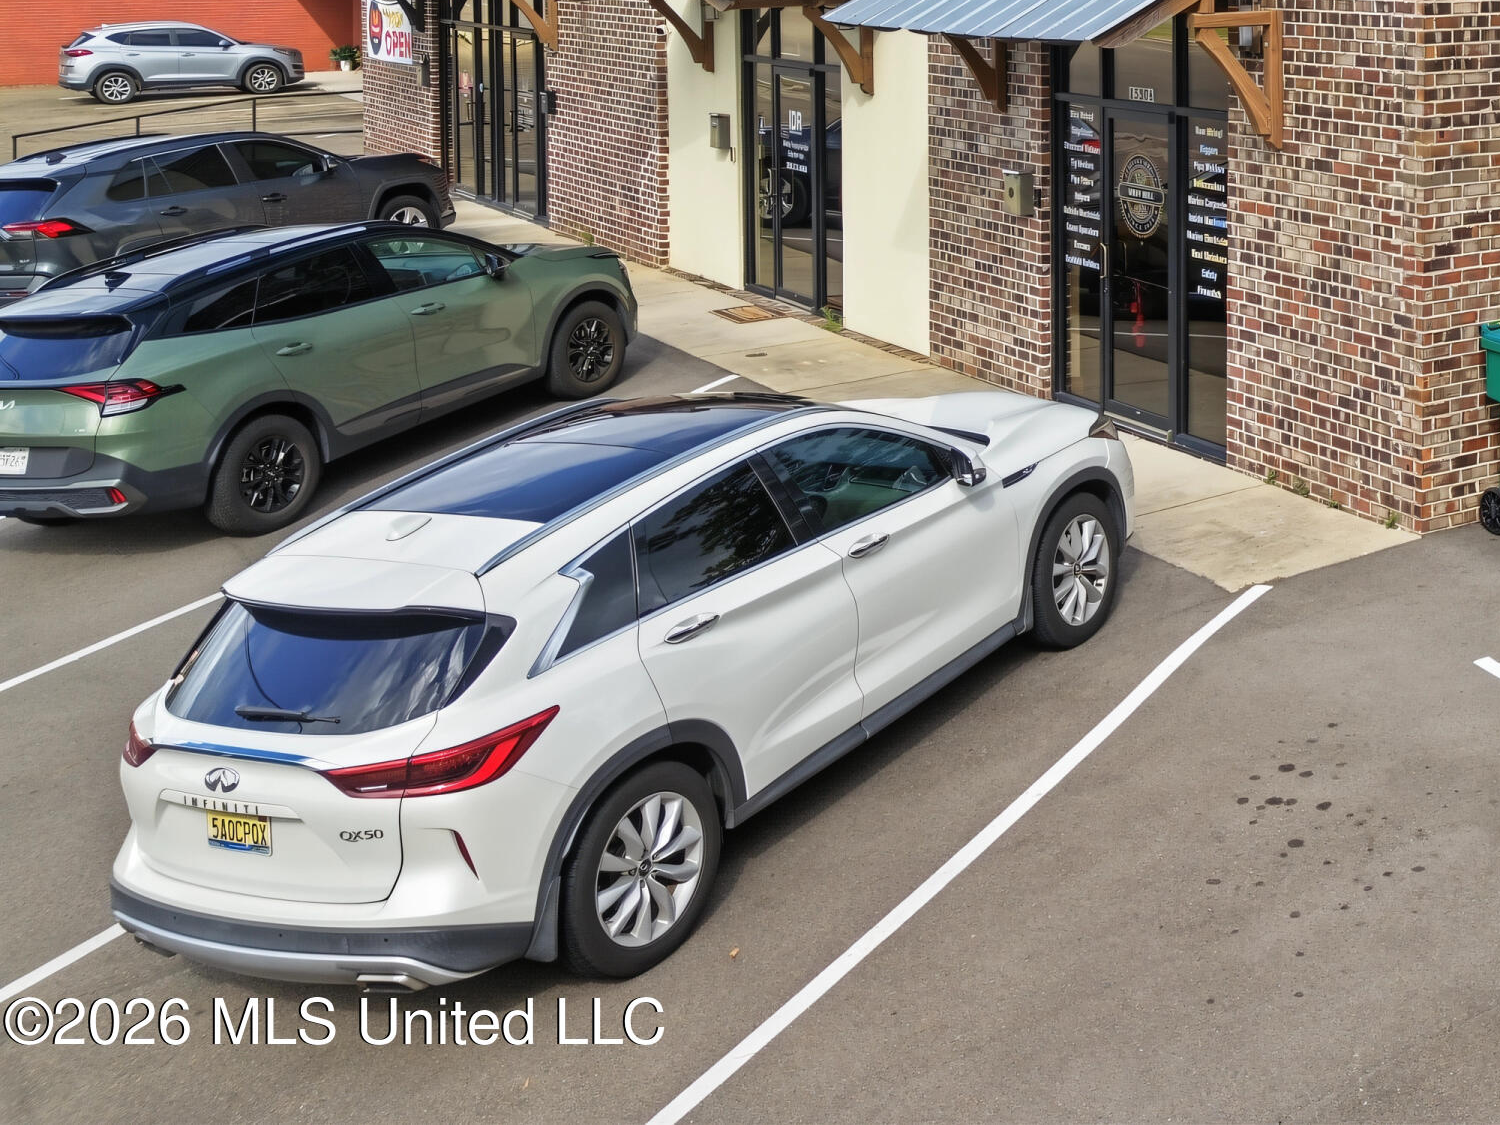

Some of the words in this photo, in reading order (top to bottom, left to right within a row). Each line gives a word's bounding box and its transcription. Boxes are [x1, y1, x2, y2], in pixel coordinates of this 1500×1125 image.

[385, 30, 411, 59] OPEN
[788, 110, 802, 131] IDR
[183, 795, 259, 815] INFINITI
[339, 829, 384, 842] QX50
